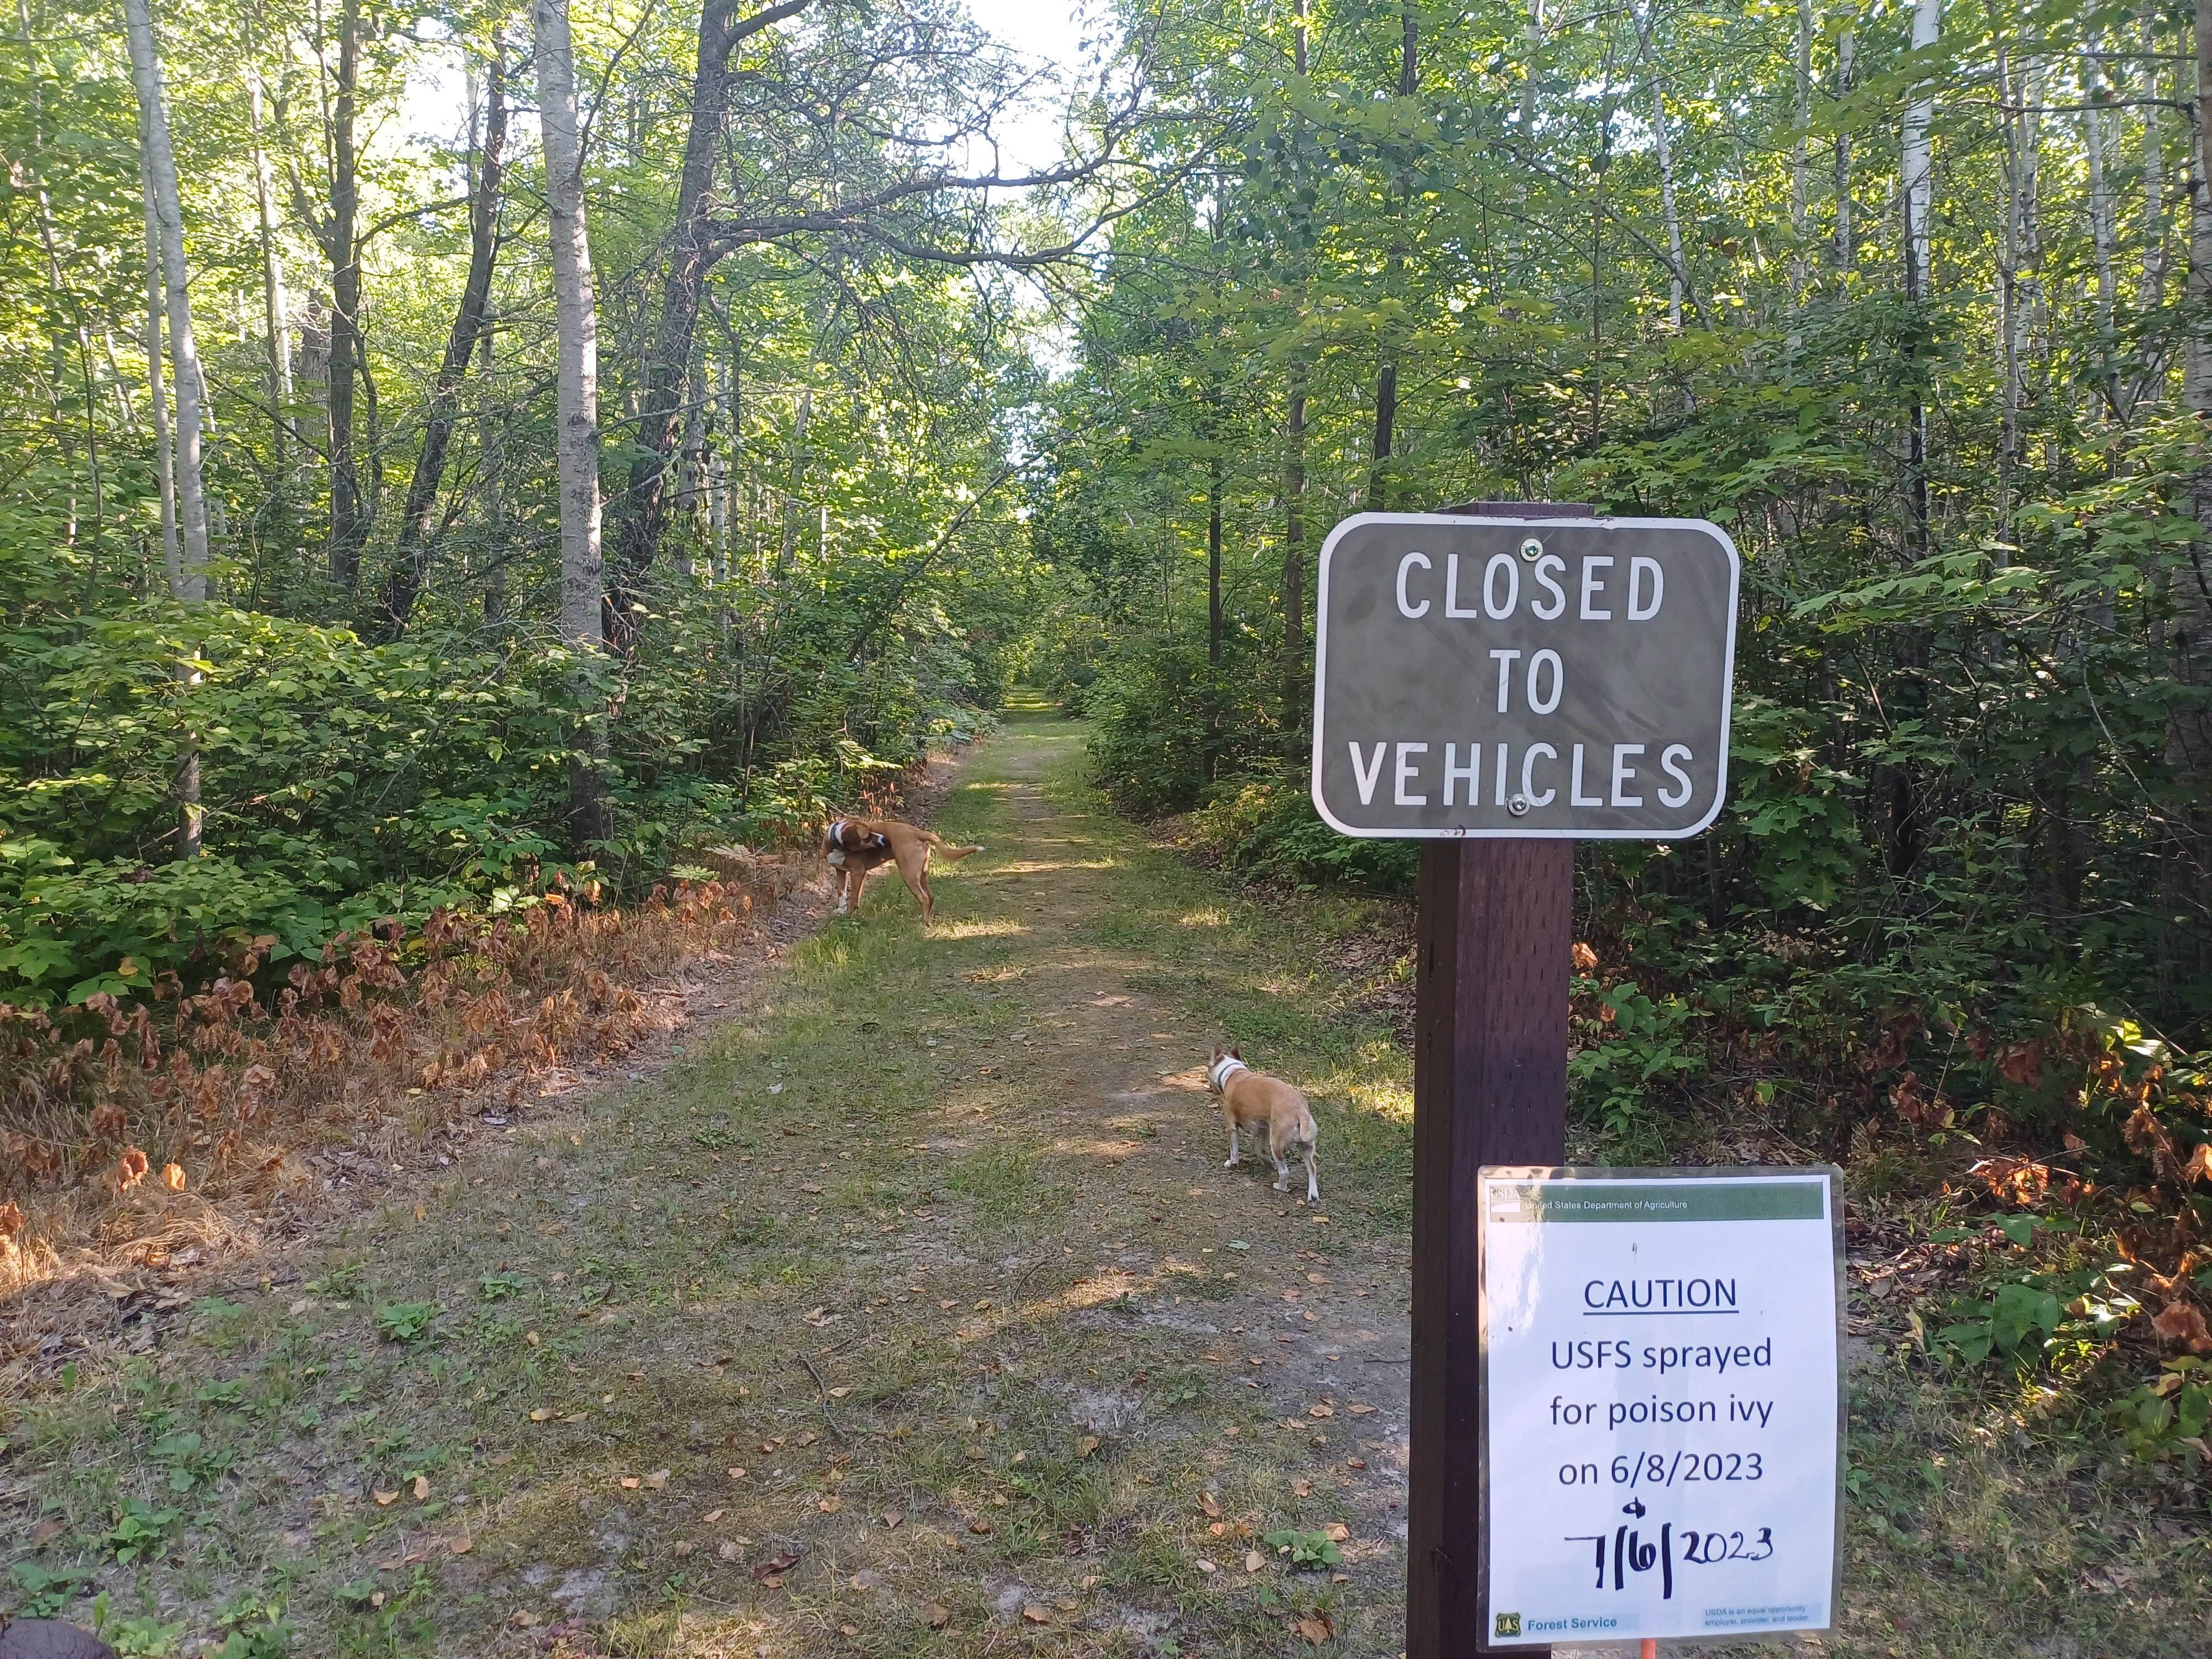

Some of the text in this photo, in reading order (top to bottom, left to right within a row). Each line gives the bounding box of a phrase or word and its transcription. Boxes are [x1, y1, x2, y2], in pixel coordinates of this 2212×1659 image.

[1396, 552, 1664, 620] CLOSED
[1490, 649, 1564, 714] TO
[1348, 742, 1693, 808] VEHICLES
[1491, 1187, 1520, 1199] USDA
[1525, 1200, 1688, 1211] United States Department of Agriculture
[1584, 1278, 1736, 1308] CAUTION
[1552, 1337, 1771, 1375] USFS sprayed
[1550, 1394, 1773, 1431] for poison ivy
[1559, 1451, 1763, 1488] on 6/8/2023
[1528, 1616, 1618, 1631] Forest Service
[1747, 1606, 1766, 1615] equal
[1768, 1605, 1806, 1614] opportunity
